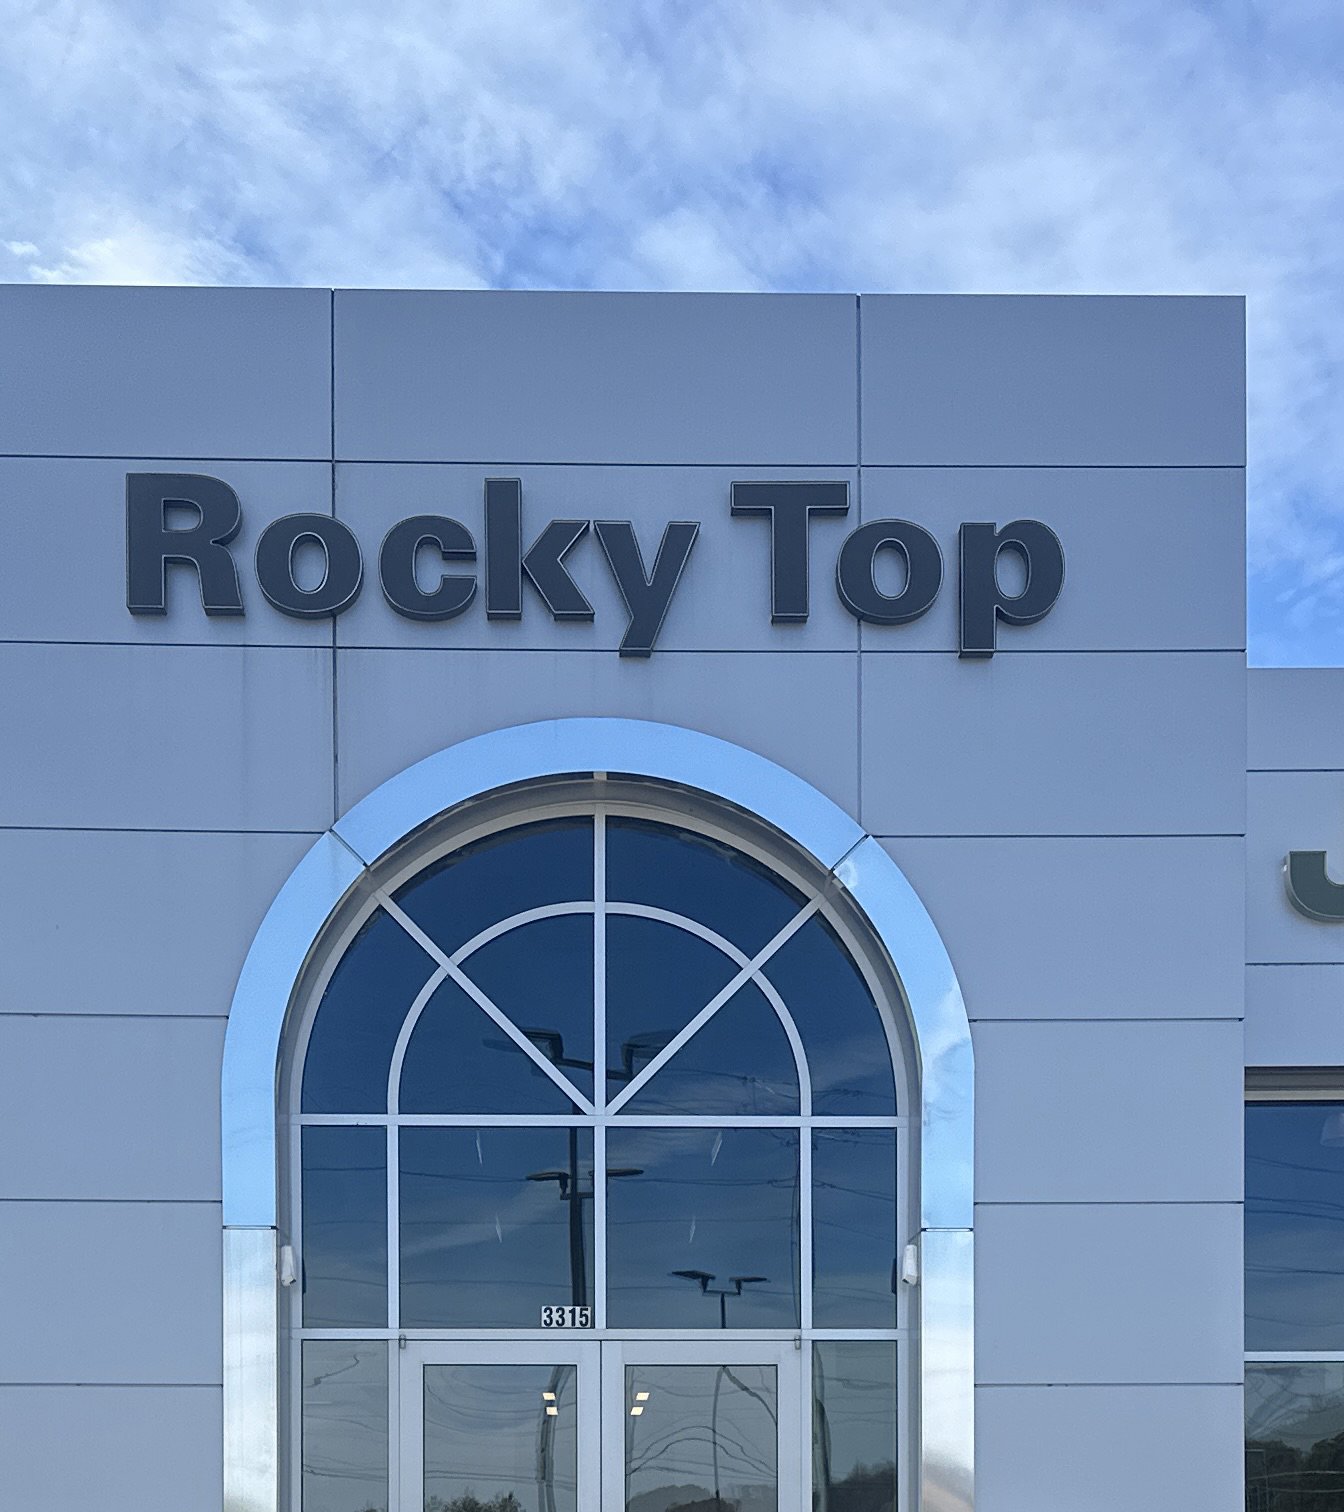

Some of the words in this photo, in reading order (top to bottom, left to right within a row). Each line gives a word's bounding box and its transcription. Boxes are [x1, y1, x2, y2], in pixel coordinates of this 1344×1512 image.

[125, 472, 700, 658] Rocky
[729, 481, 1066, 658] Top
[543, 1306, 589, 1327] 3315
